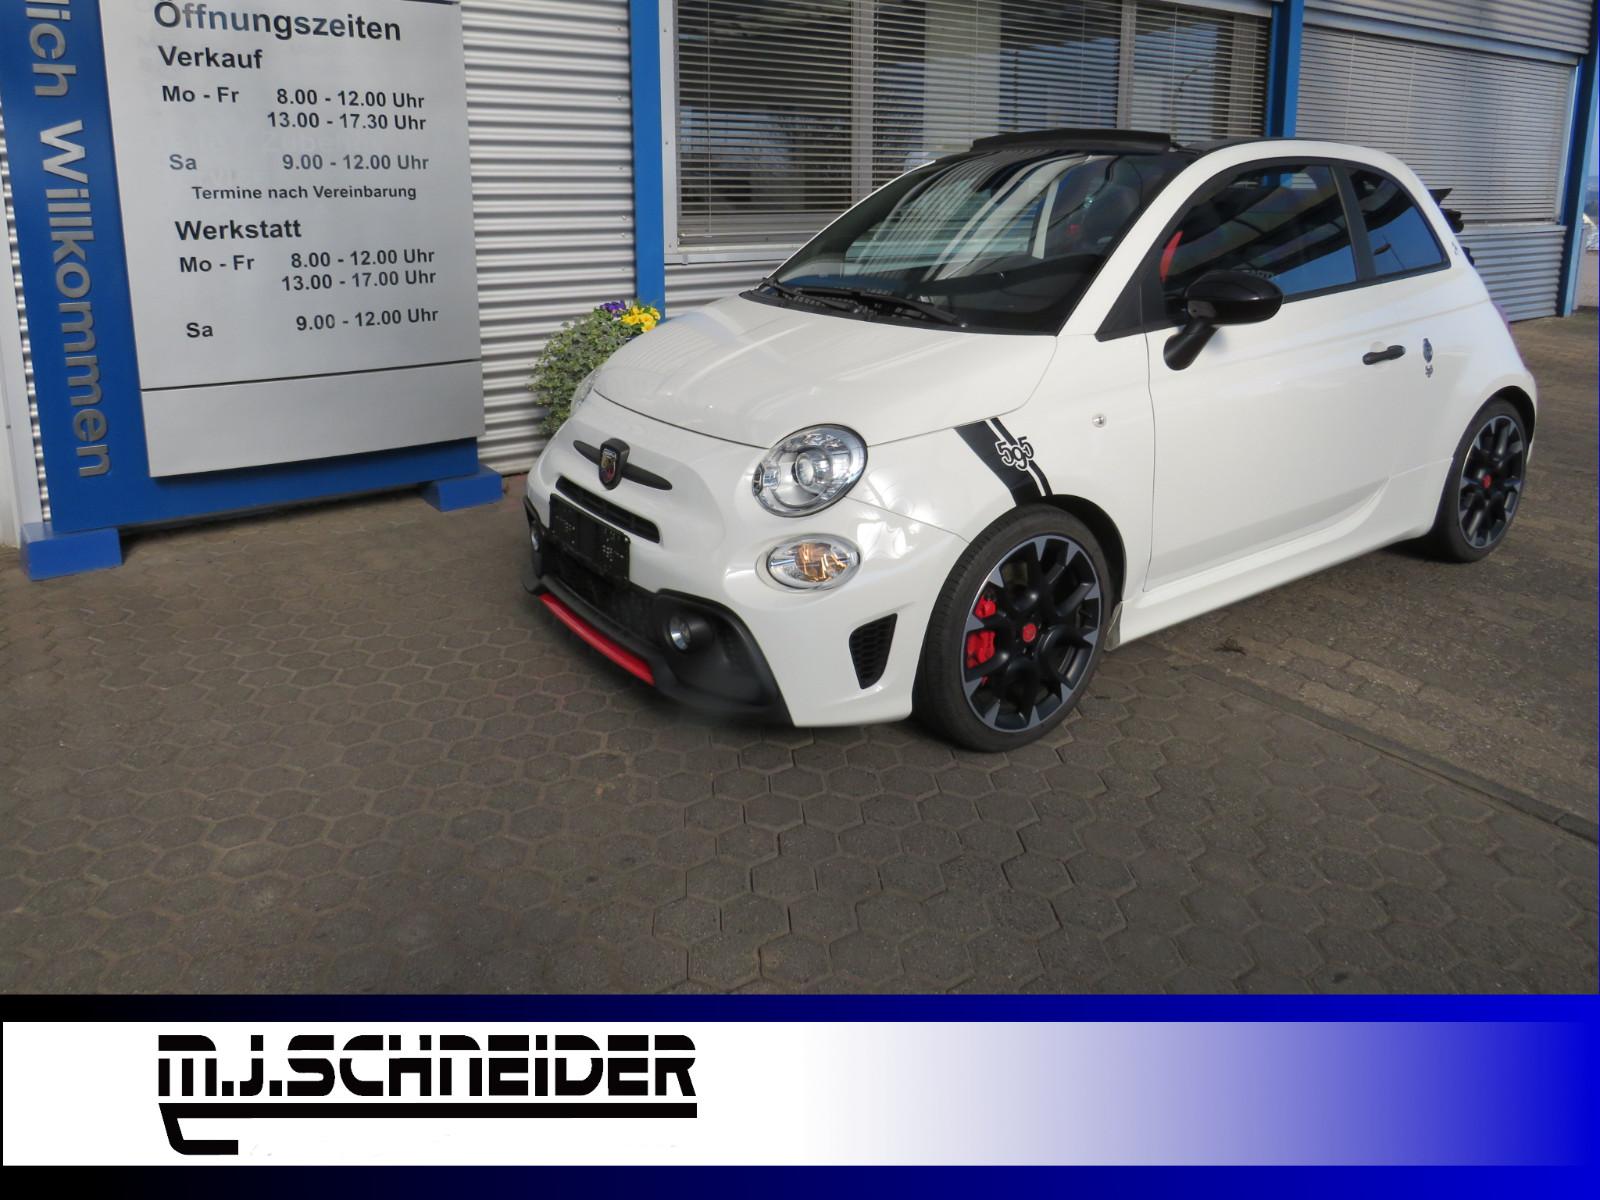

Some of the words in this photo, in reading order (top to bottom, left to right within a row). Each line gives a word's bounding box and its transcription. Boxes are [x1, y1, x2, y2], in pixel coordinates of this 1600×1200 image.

[157, 45, 263, 69] Verkauf
[161, 85, 196, 103] Mo
[217, 86, 240, 103] Fr
[276, 88, 318, 106] 8.00
[337, 90, 387, 108] 12.00
[392, 92, 425, 109] Uhr
[267, 111, 320, 129] 13.00
[339, 113, 388, 130] 17.30
[394, 114, 427, 130] Uhr
[169, 153, 197, 171] Sa
[282, 153, 323, 170] 9.00
[343, 154, 391, 170] 12.00
[397, 154, 429, 170] Uhr
[191, 185, 263, 200] Termine
[267, 185, 308, 199] nach
[312, 185, 417, 201] Vereinbarung
[174, 219, 302, 241] Werkstatt
[179, 256, 212, 273] Mo
[233, 254, 255, 271] Fr
[291, 251, 331, 269] 8.00
[350, 249, 398, 266] 12.00
[403, 248, 435, 264] Uhr
[281, 273, 333, 292] 13.00
[351, 270, 399, 288] 17.00
[404, 269, 437, 285] Uhr
[39, 119, 111, 478] Willkommen
[186, 322, 214, 339] Sa
[295, 313, 336, 332] 9.00
[354, 309, 402, 327] 12.00
[407, 307, 439, 324] Uhr
[994, 435, 1034, 471] 595
